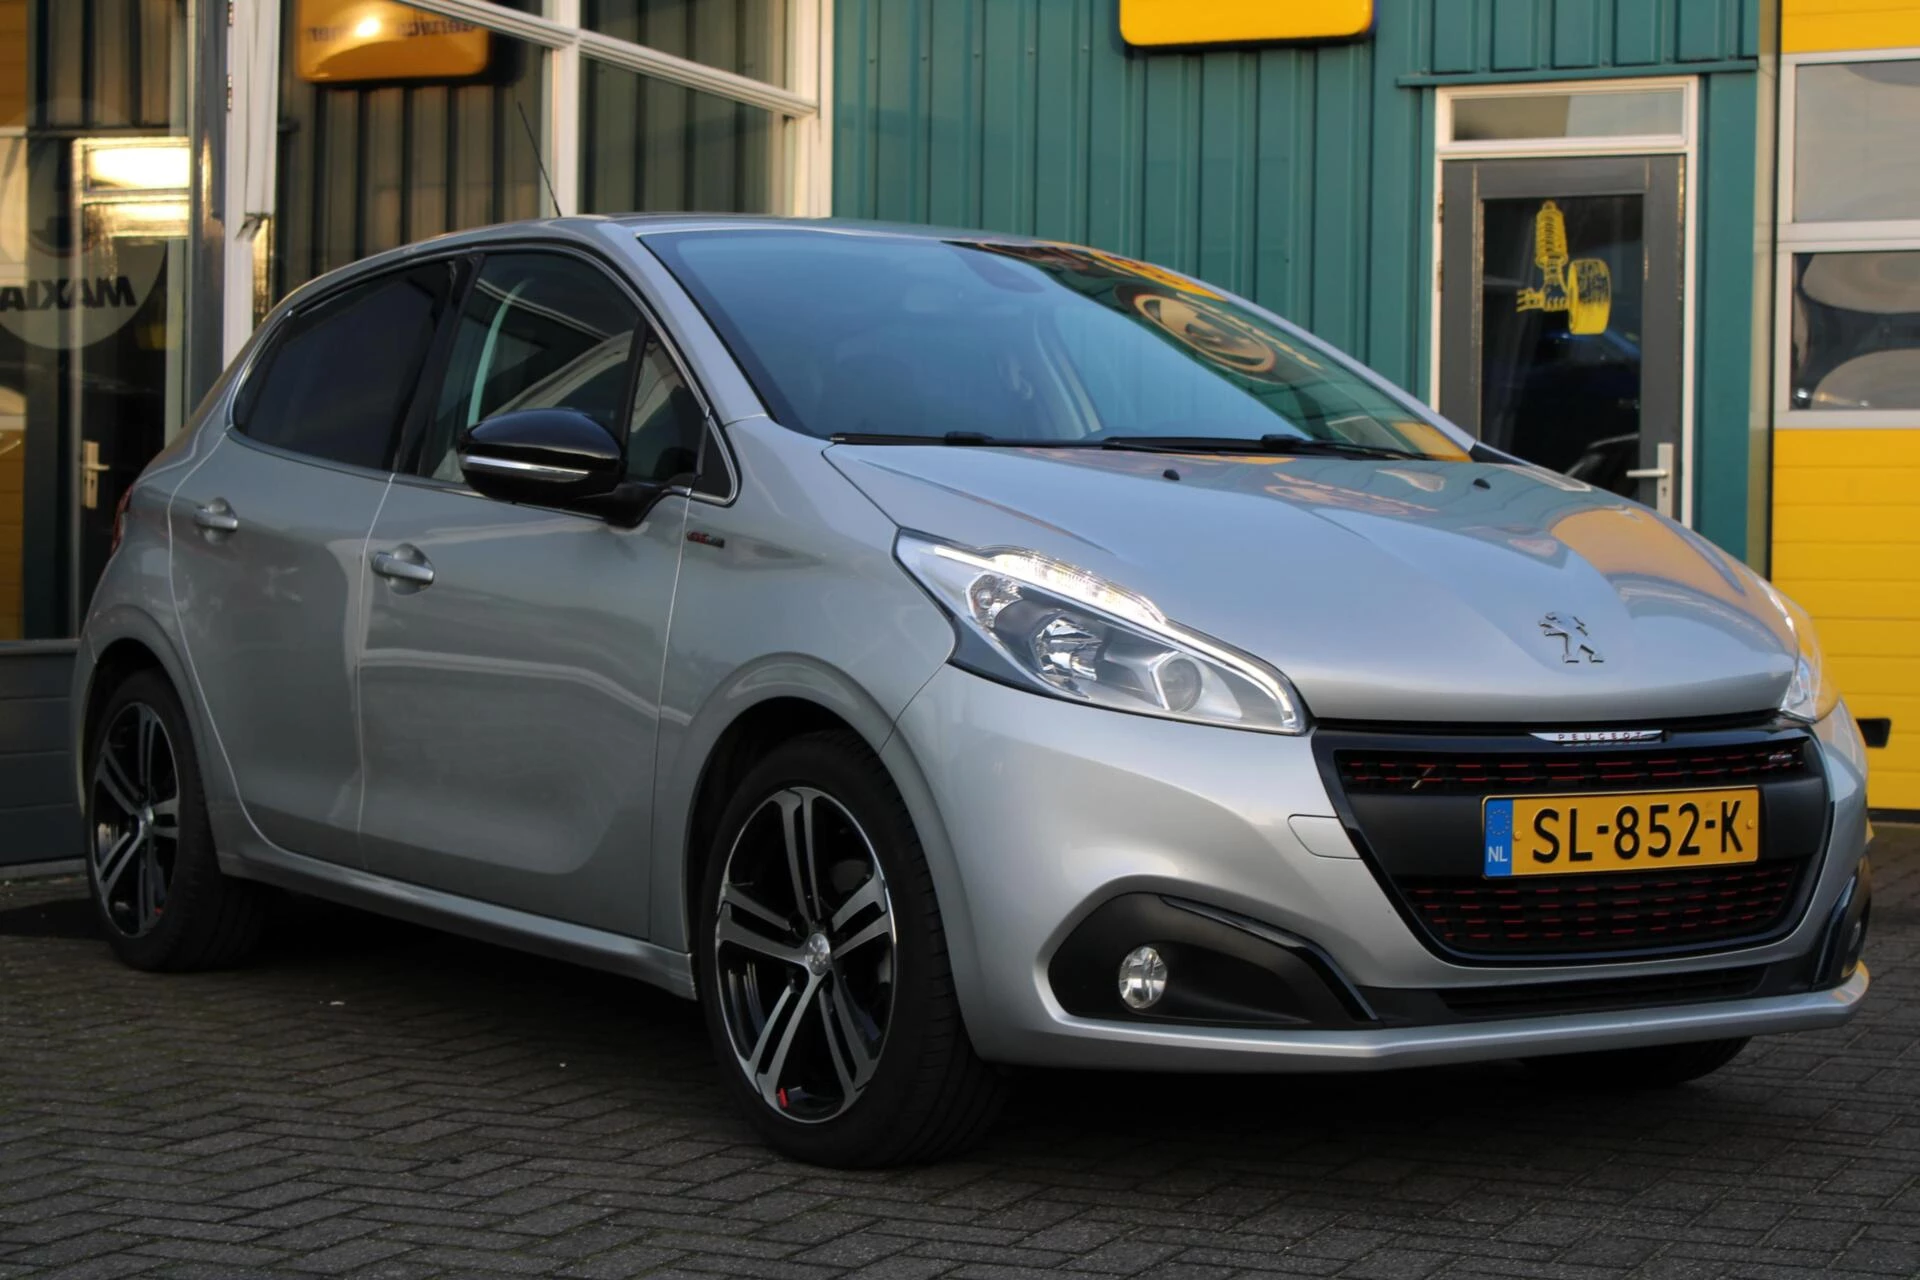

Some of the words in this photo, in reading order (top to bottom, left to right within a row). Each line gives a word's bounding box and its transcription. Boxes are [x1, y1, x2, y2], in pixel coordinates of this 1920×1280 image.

[1557, 731, 1643, 741] PEUGEOT
[1532, 800, 1743, 863] SL-852-K
[1488, 846, 1508, 862] NL
